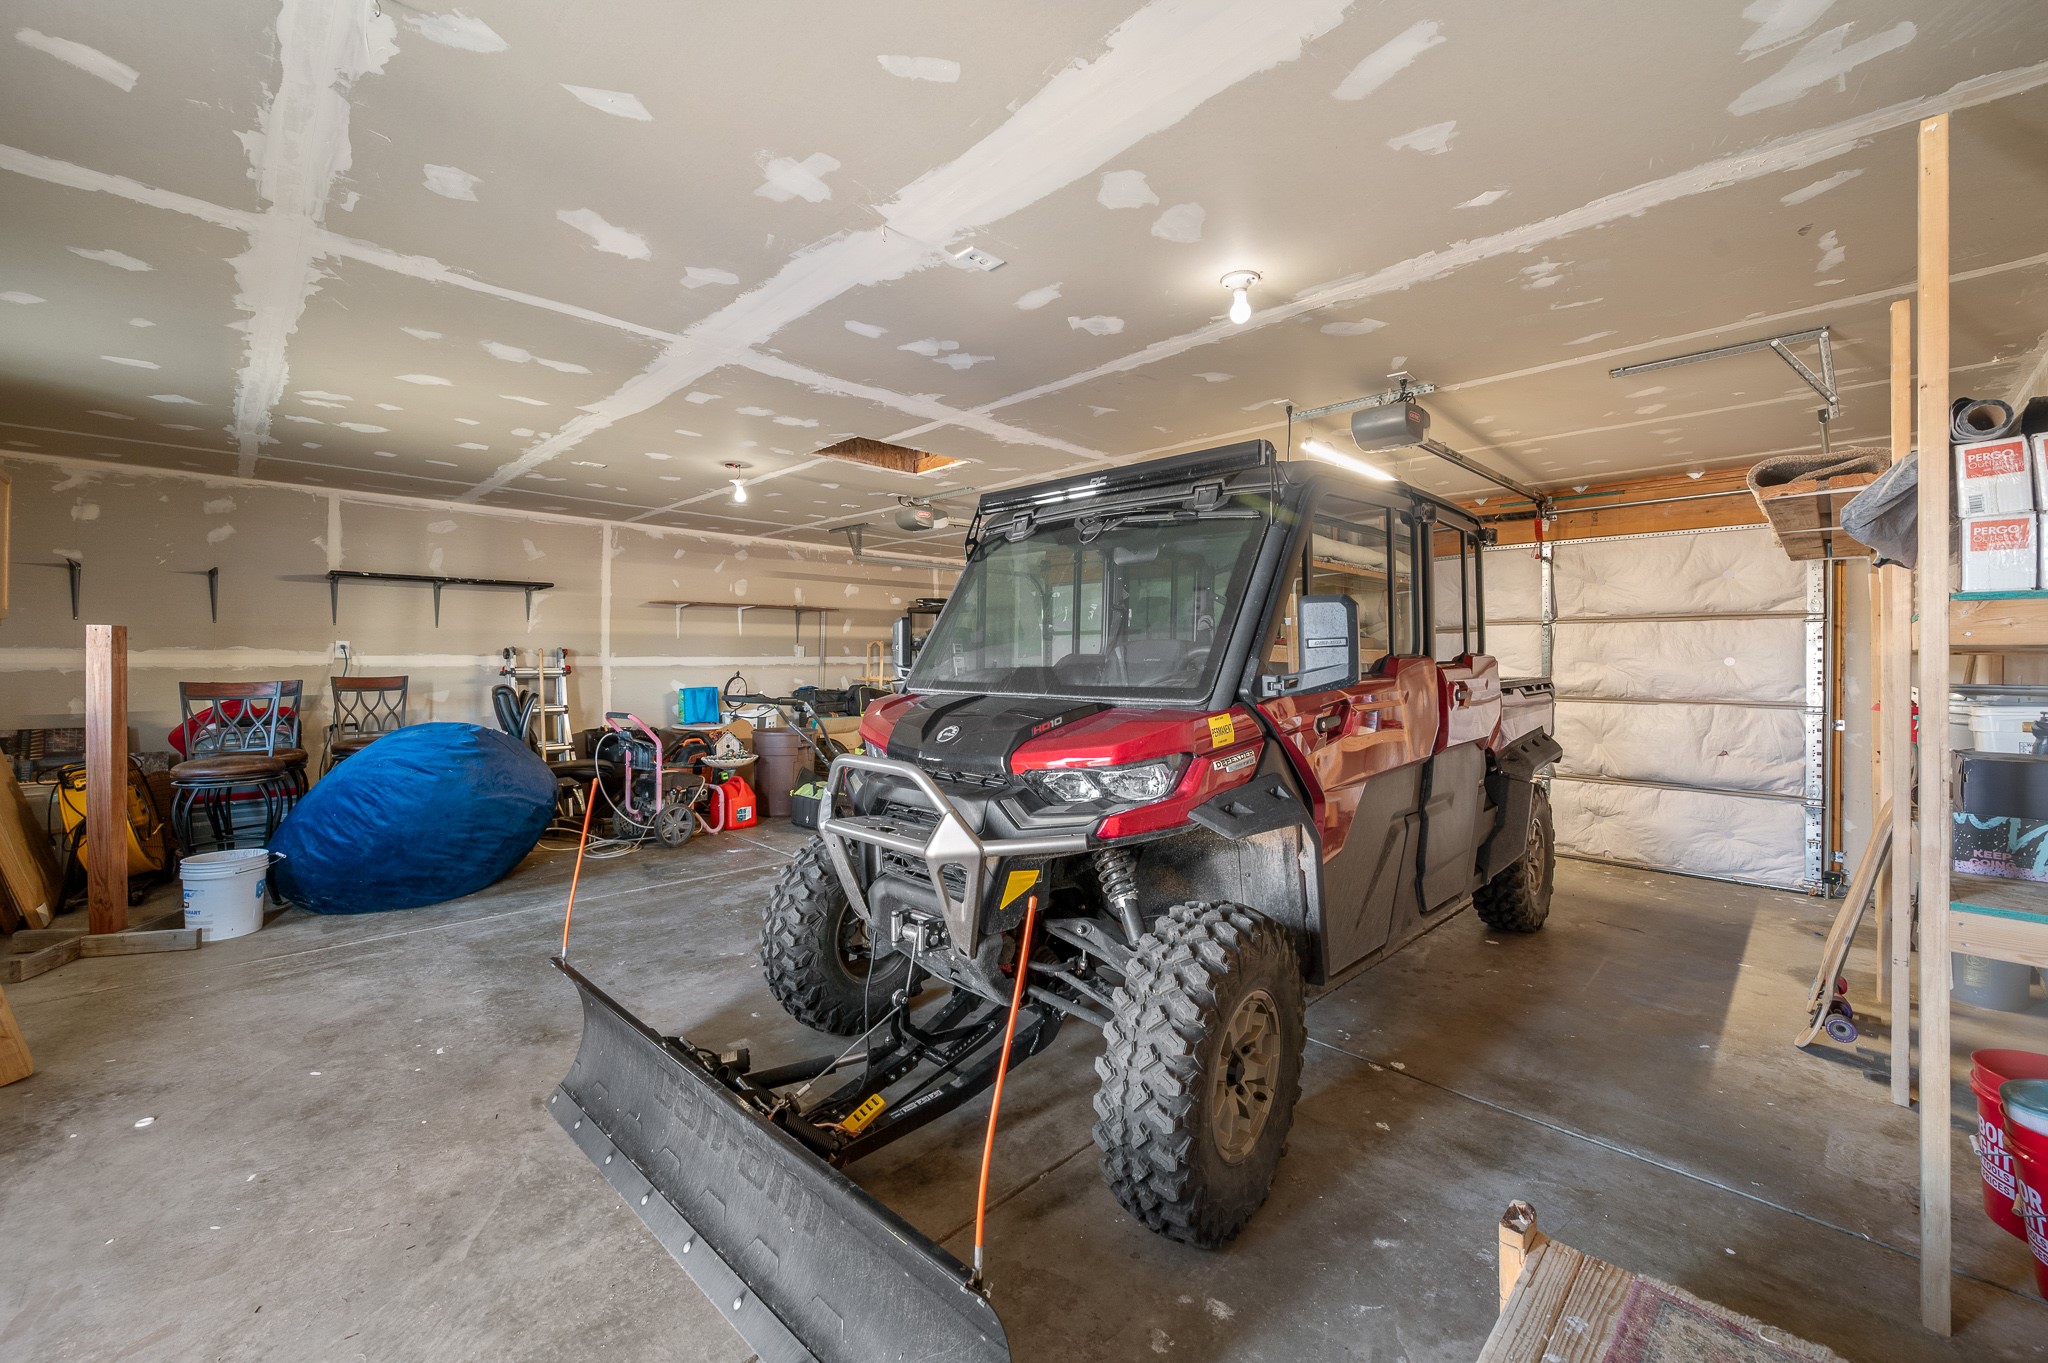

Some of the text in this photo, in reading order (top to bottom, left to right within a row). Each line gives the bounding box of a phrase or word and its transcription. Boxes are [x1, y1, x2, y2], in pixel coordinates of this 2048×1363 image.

[1968, 448, 2015, 463] PERGO
[1973, 524, 2020, 536] PERGO
[1033, 716, 1063, 735] HD10
[1216, 751, 1255, 768] DEFENDER
[1973, 848, 2012, 860] KEEP
[1969, 858, 2017, 870] GOING
[1982, 1156, 2010, 1183] TOOLS
[1982, 1169, 2010, 1196] PRICES
